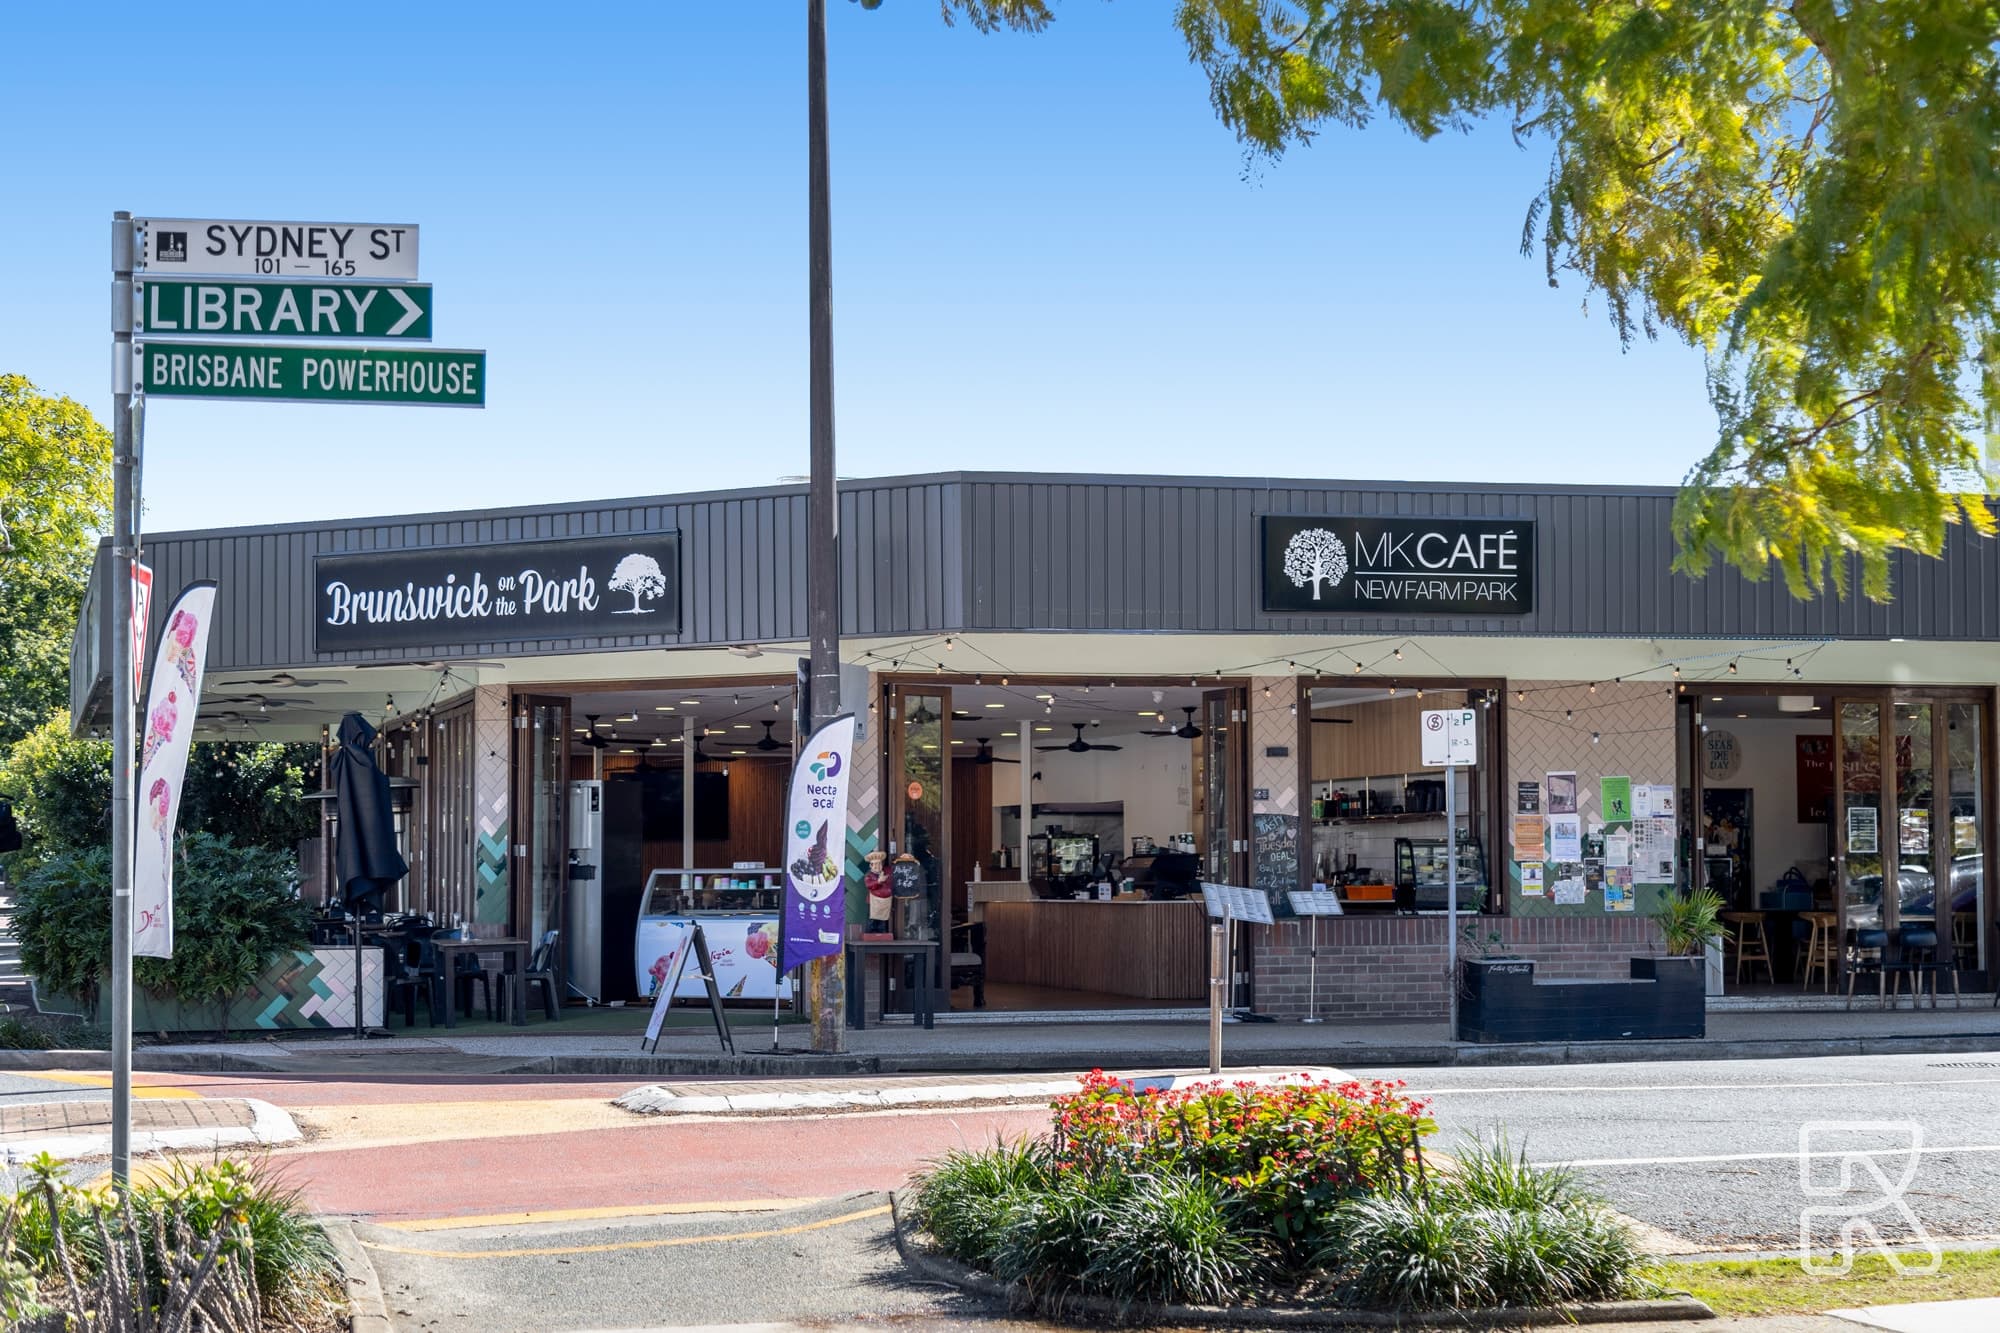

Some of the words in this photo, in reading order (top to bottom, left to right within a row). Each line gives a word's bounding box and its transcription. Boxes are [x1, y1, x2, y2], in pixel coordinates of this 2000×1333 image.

[206, 224, 354, 258] SYDNEY
[369, 228, 406, 260] ST
[254, 257, 281, 274] 101
[324, 259, 356, 276] 165
[150, 285, 379, 333] LIBRARY
[152, 353, 283, 389] BRISBANE
[302, 357, 477, 395] POWERHOUSE
[498, 575, 516, 592] on
[518, 565, 600, 615] Park
[1354, 579, 1403, 600] NEW
[1404, 580, 1461, 601] FARM
[1463, 581, 1518, 601] PARK
[326, 571, 493, 626] Brunswick
[495, 596, 517, 617] the
[1710, 760, 1729, 770] DAY
[806, 784, 838, 796] Necta
[812, 797, 835, 809] açaí
[1255, 836, 1297, 855] Tuesday
[1270, 851, 1291, 862] DEAL
